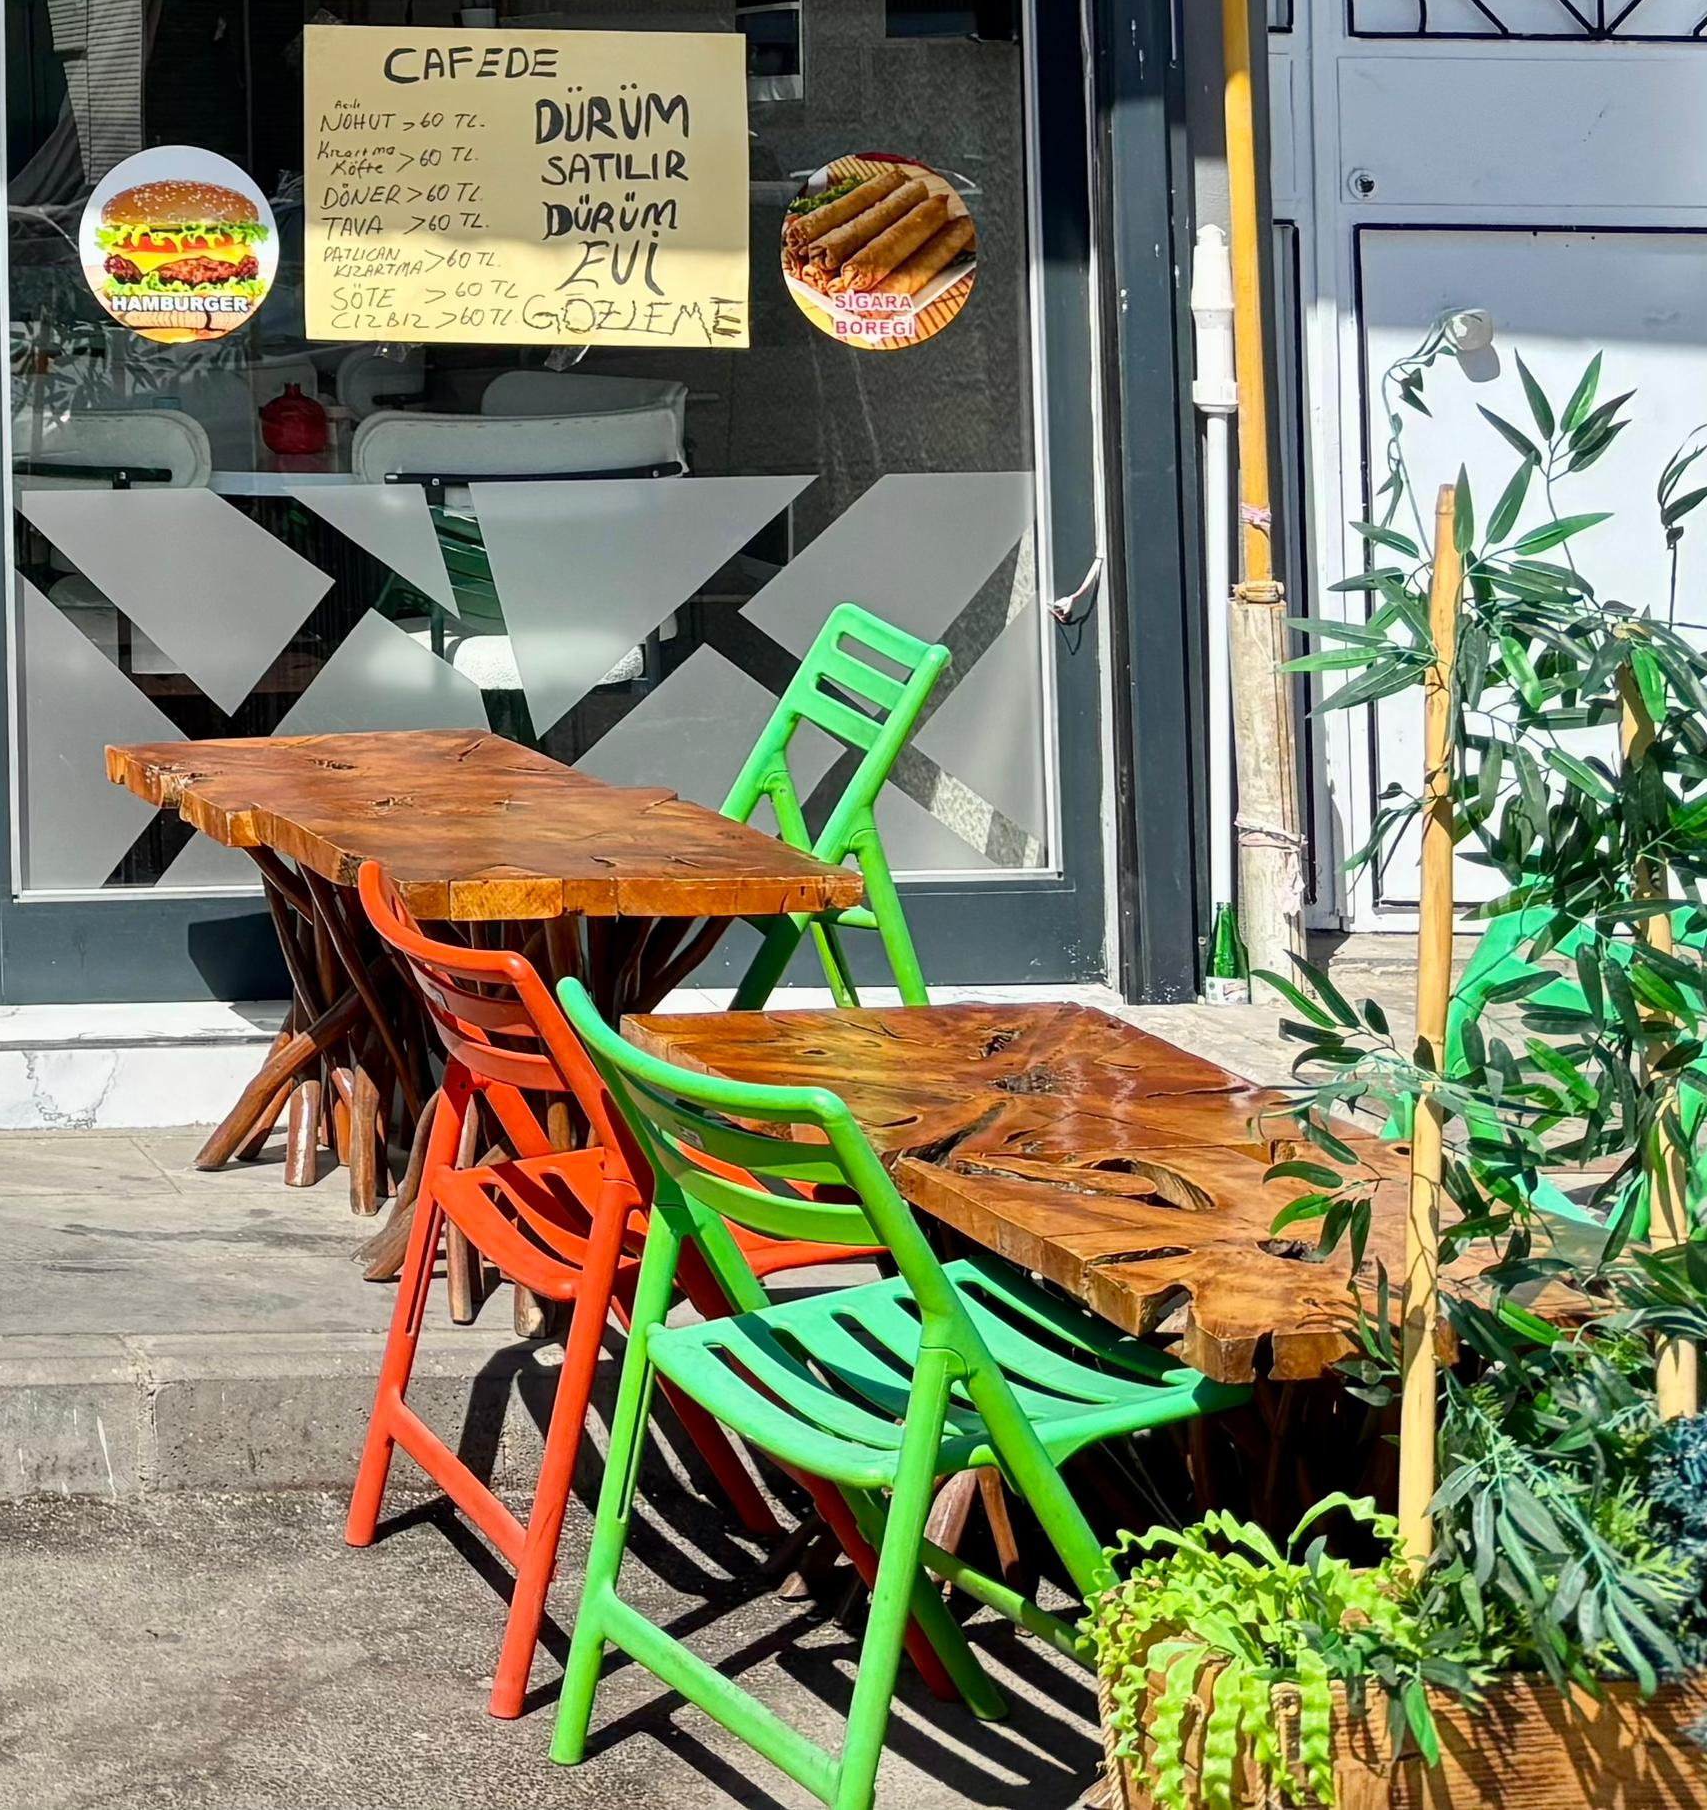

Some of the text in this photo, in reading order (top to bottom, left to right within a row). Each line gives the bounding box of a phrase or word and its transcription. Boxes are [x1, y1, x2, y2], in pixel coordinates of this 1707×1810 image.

[384, 46, 559, 83] CAFEDE
[320, 113, 396, 132] NOHUT
[535, 83, 689, 144] DÜRÜM
[541, 150, 689, 185] SATILIR
[320, 183, 401, 210] DÖNER
[321, 214, 383, 241] TAVA
[542, 192, 677, 240] DÜRÜM
[323, 246, 400, 262] PATLICAN
[334, 260, 423, 277] KIZARTMA
[112, 295, 249, 312] HAMBURGER
[331, 283, 396, 311] SÖTE
[455, 281, 483, 297] 60
